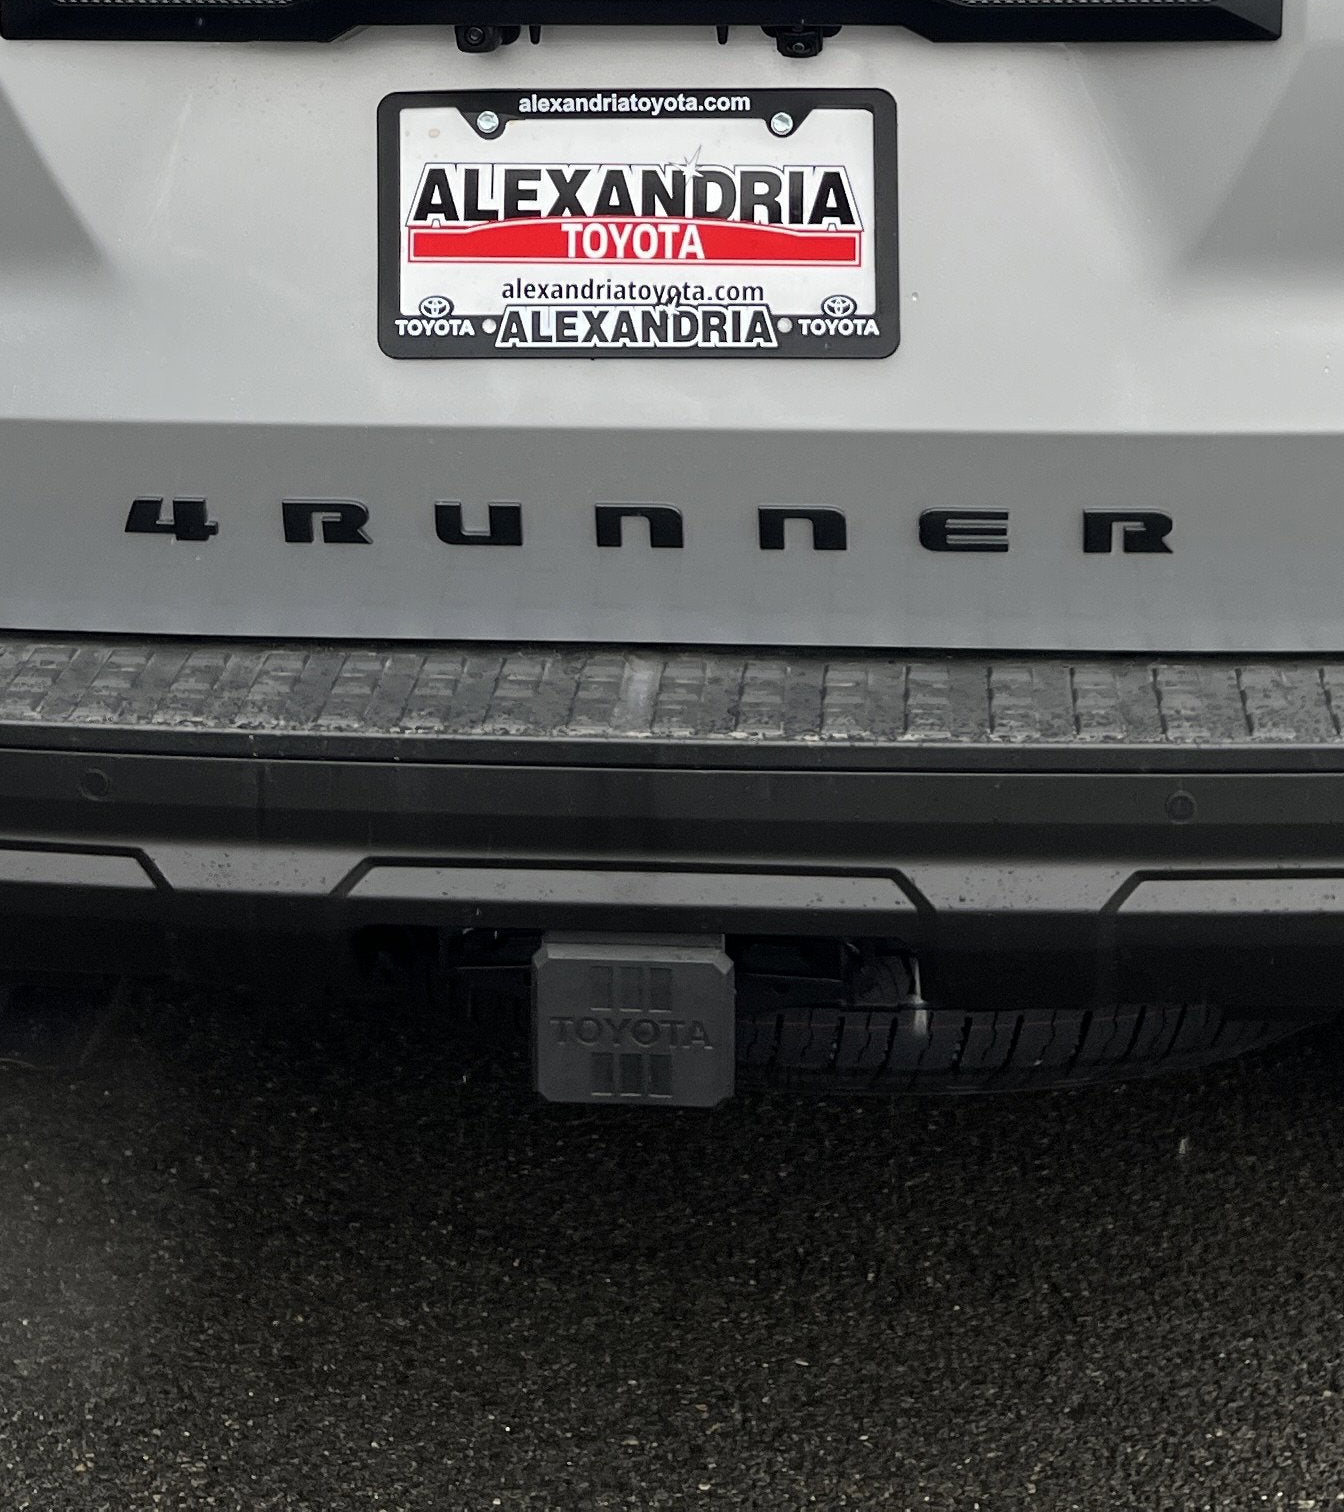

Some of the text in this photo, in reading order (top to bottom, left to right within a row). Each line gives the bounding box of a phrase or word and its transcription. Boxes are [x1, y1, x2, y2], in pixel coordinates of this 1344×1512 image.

[518, 93, 751, 116] alexandriatoyota.com
[412, 166, 857, 226] ALEXANDRIA
[561, 222, 706, 260] TOYOTA
[501, 277, 765, 304] alexandriatoyota.com
[395, 319, 475, 337] TOYOTA
[497, 307, 777, 346] ALEXANDRIA
[798, 319, 880, 337] TOYOTA
[123, 495, 1175, 554] 4RUNNER
[549, 1016, 714, 1050] TOYOTA
